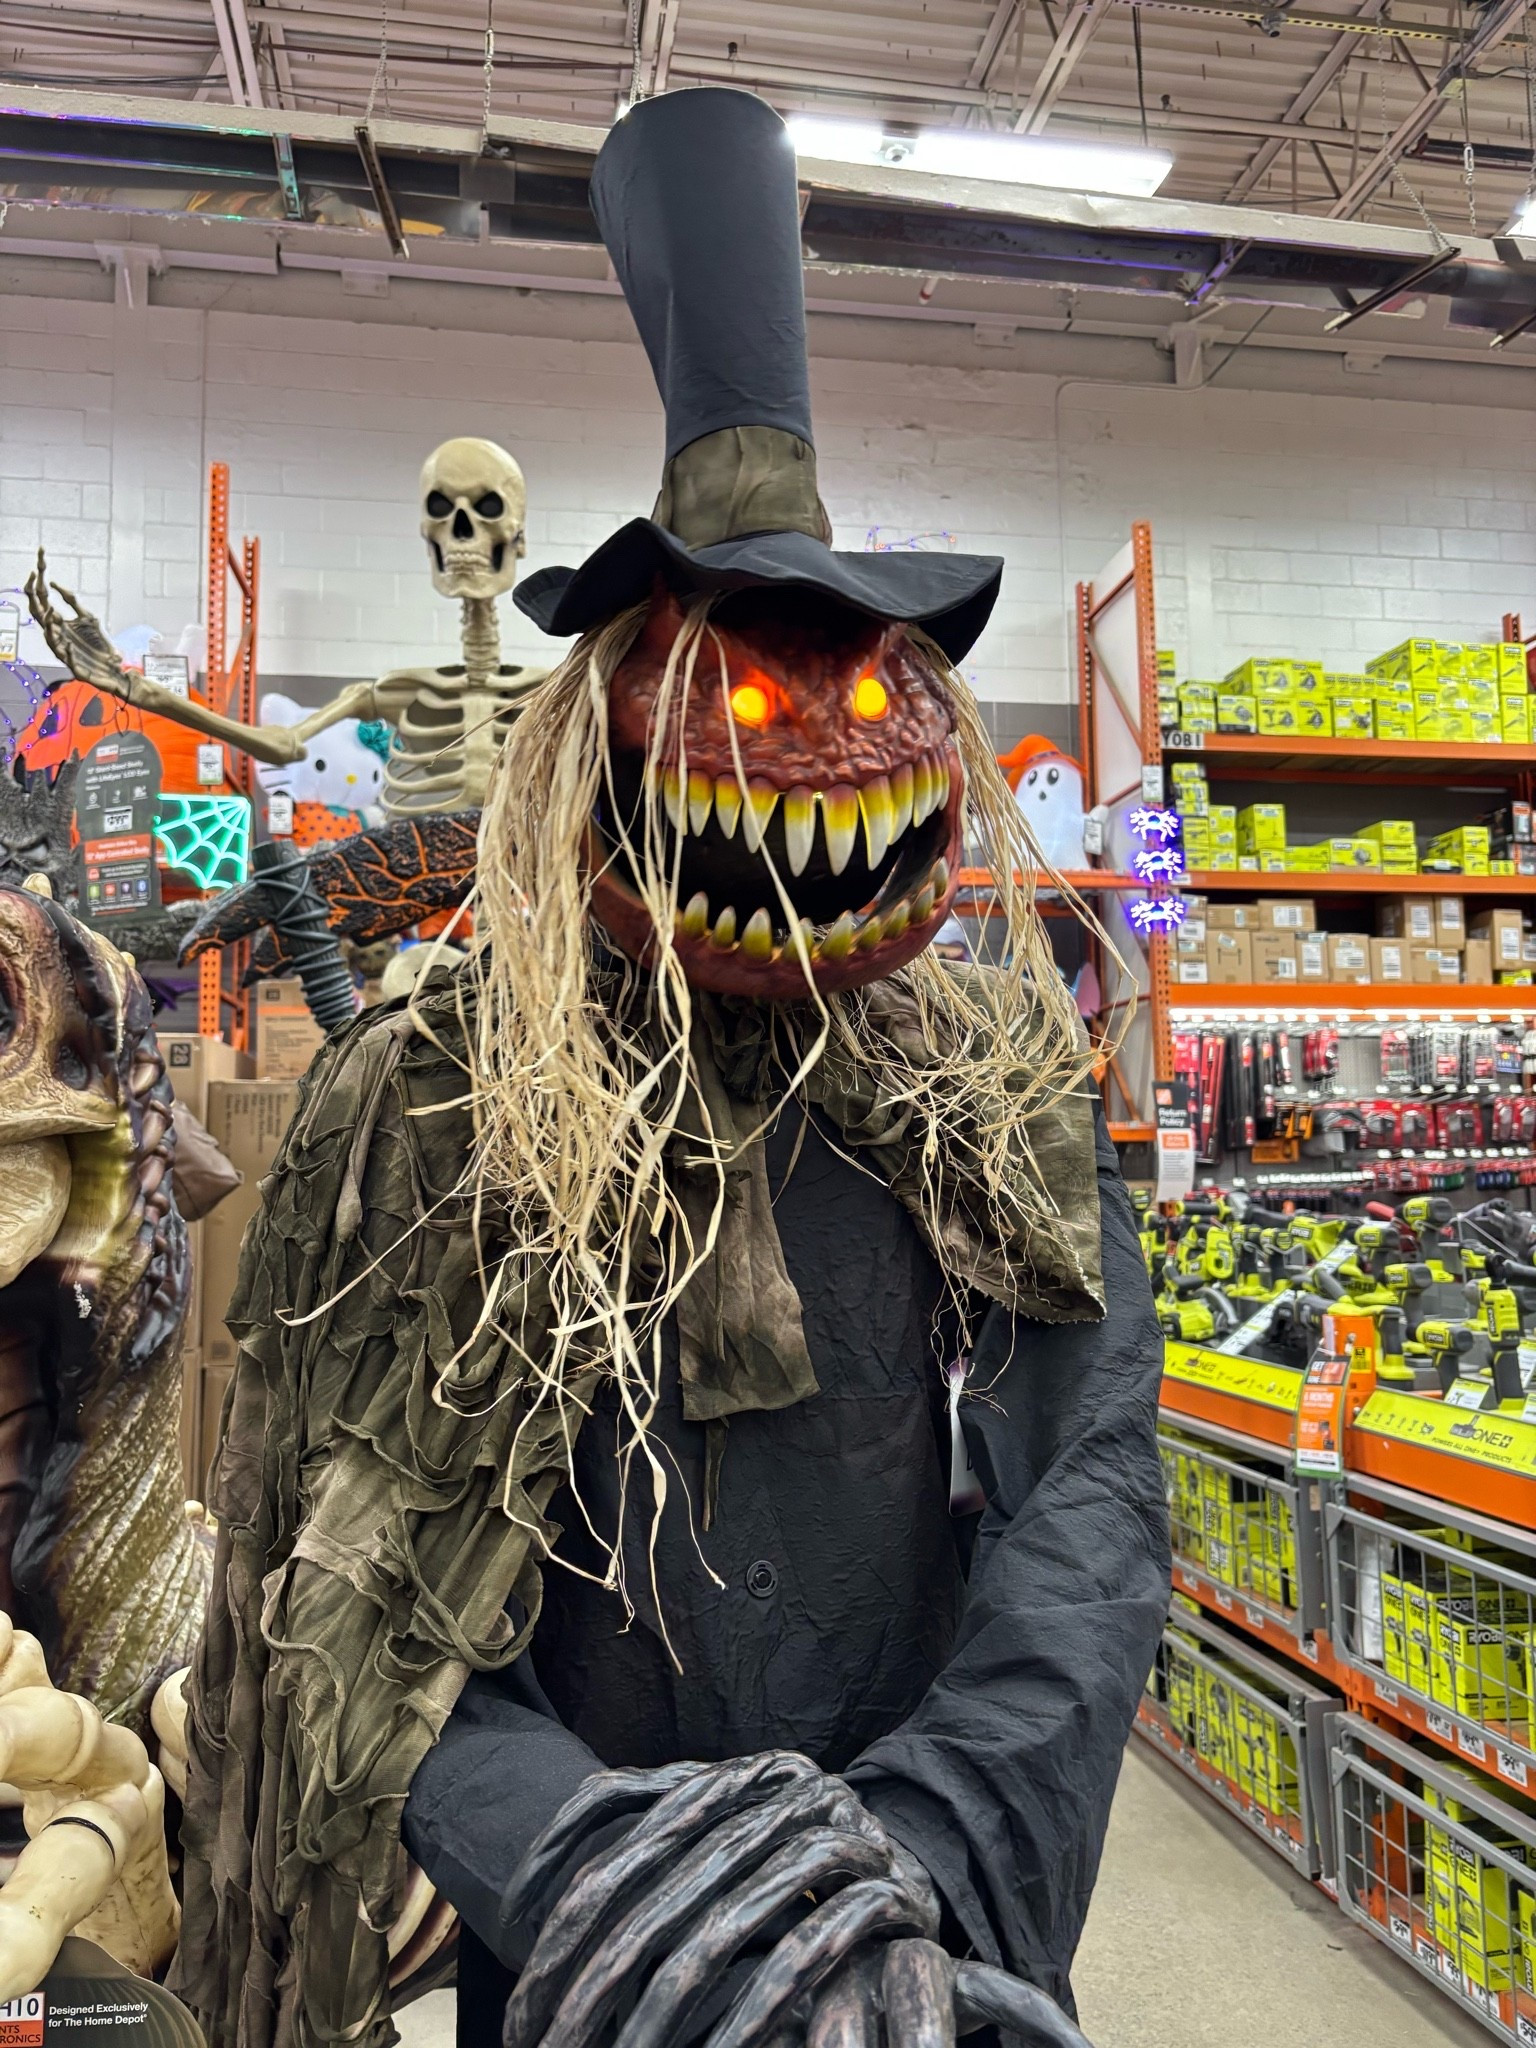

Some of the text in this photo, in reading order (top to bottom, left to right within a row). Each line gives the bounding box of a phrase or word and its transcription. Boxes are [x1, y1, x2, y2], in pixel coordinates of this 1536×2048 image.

[1159, 1107, 1187, 1118] Return
[1160, 1117, 1185, 1128] Policy
[49, 2002, 148, 2016] Designed Exclusively
[48, 2018, 62, 2028] for
[64, 2018, 82, 2027] The
[84, 2016, 113, 2026] Home
